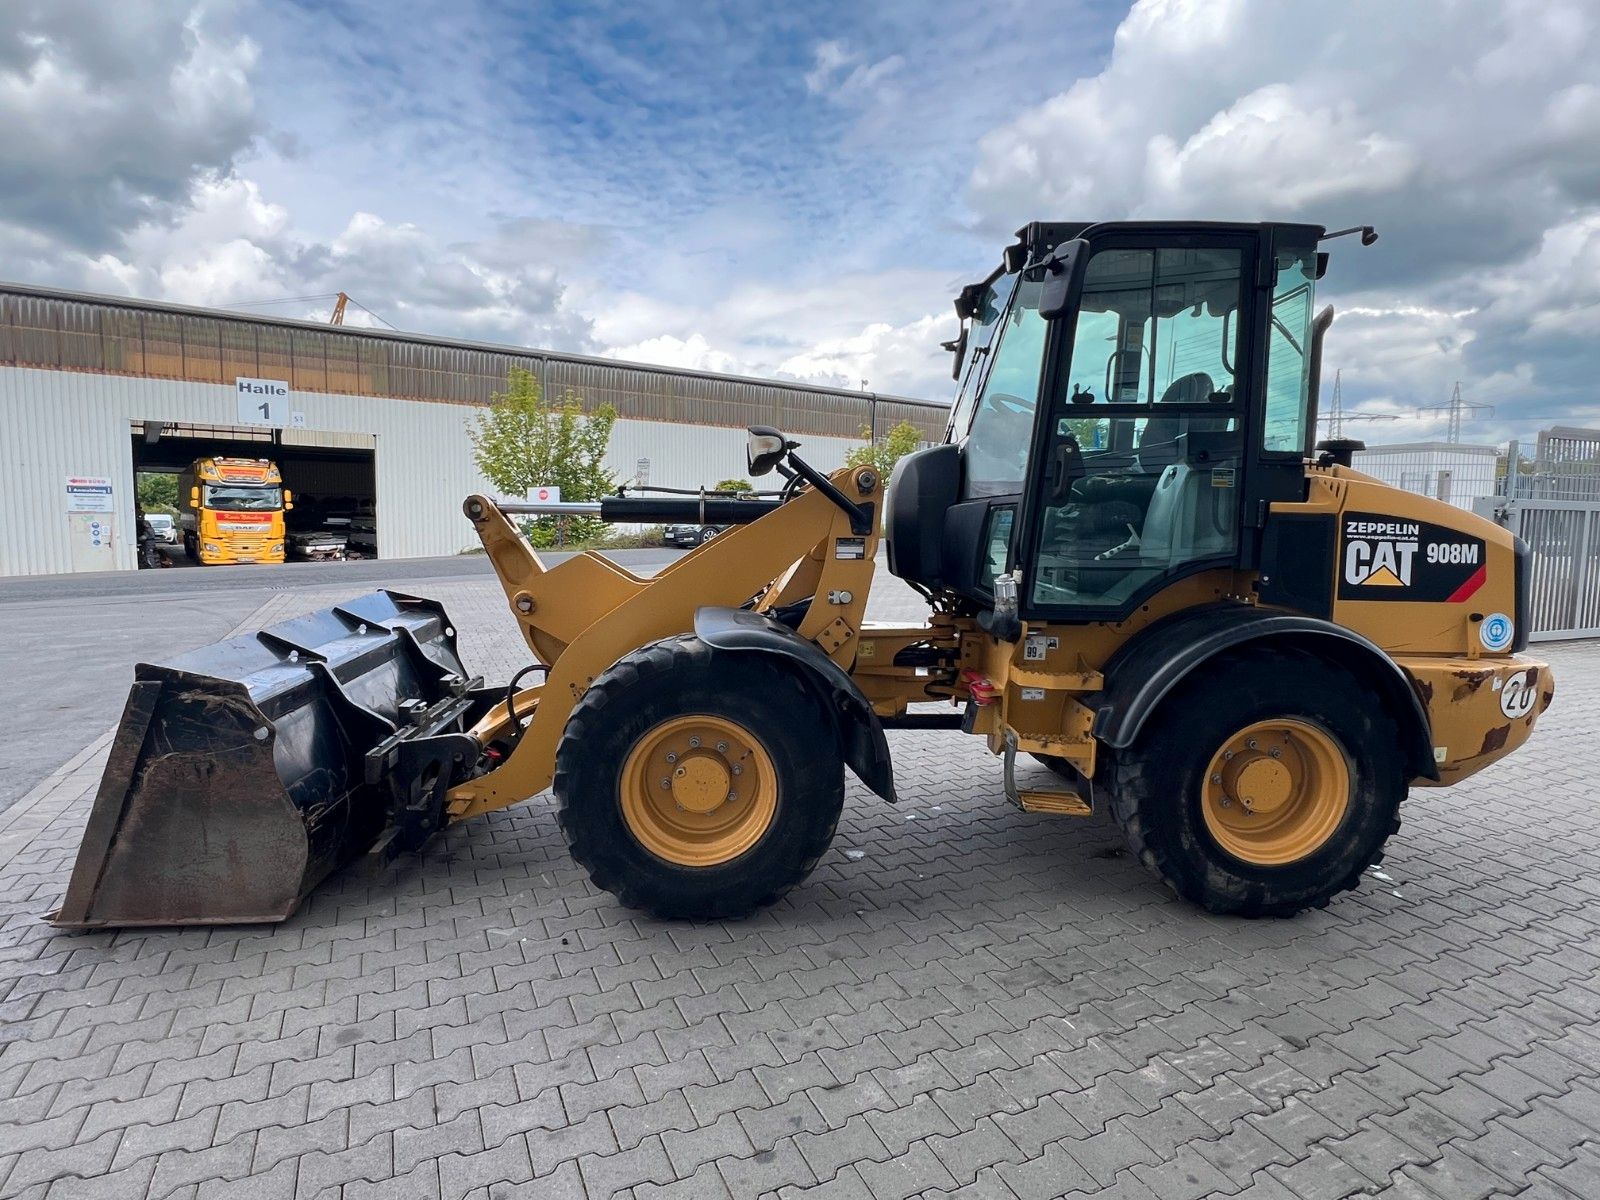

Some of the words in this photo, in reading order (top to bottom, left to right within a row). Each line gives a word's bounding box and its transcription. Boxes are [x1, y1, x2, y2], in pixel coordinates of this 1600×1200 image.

[239, 382, 287, 396] Halle
[258, 402, 270, 420] 1
[1346, 521, 1420, 535] ZEPPELIN
[1345, 540, 1419, 587] CAT
[1426, 543, 1479, 564] 908M
[1506, 681, 1531, 710] 20
